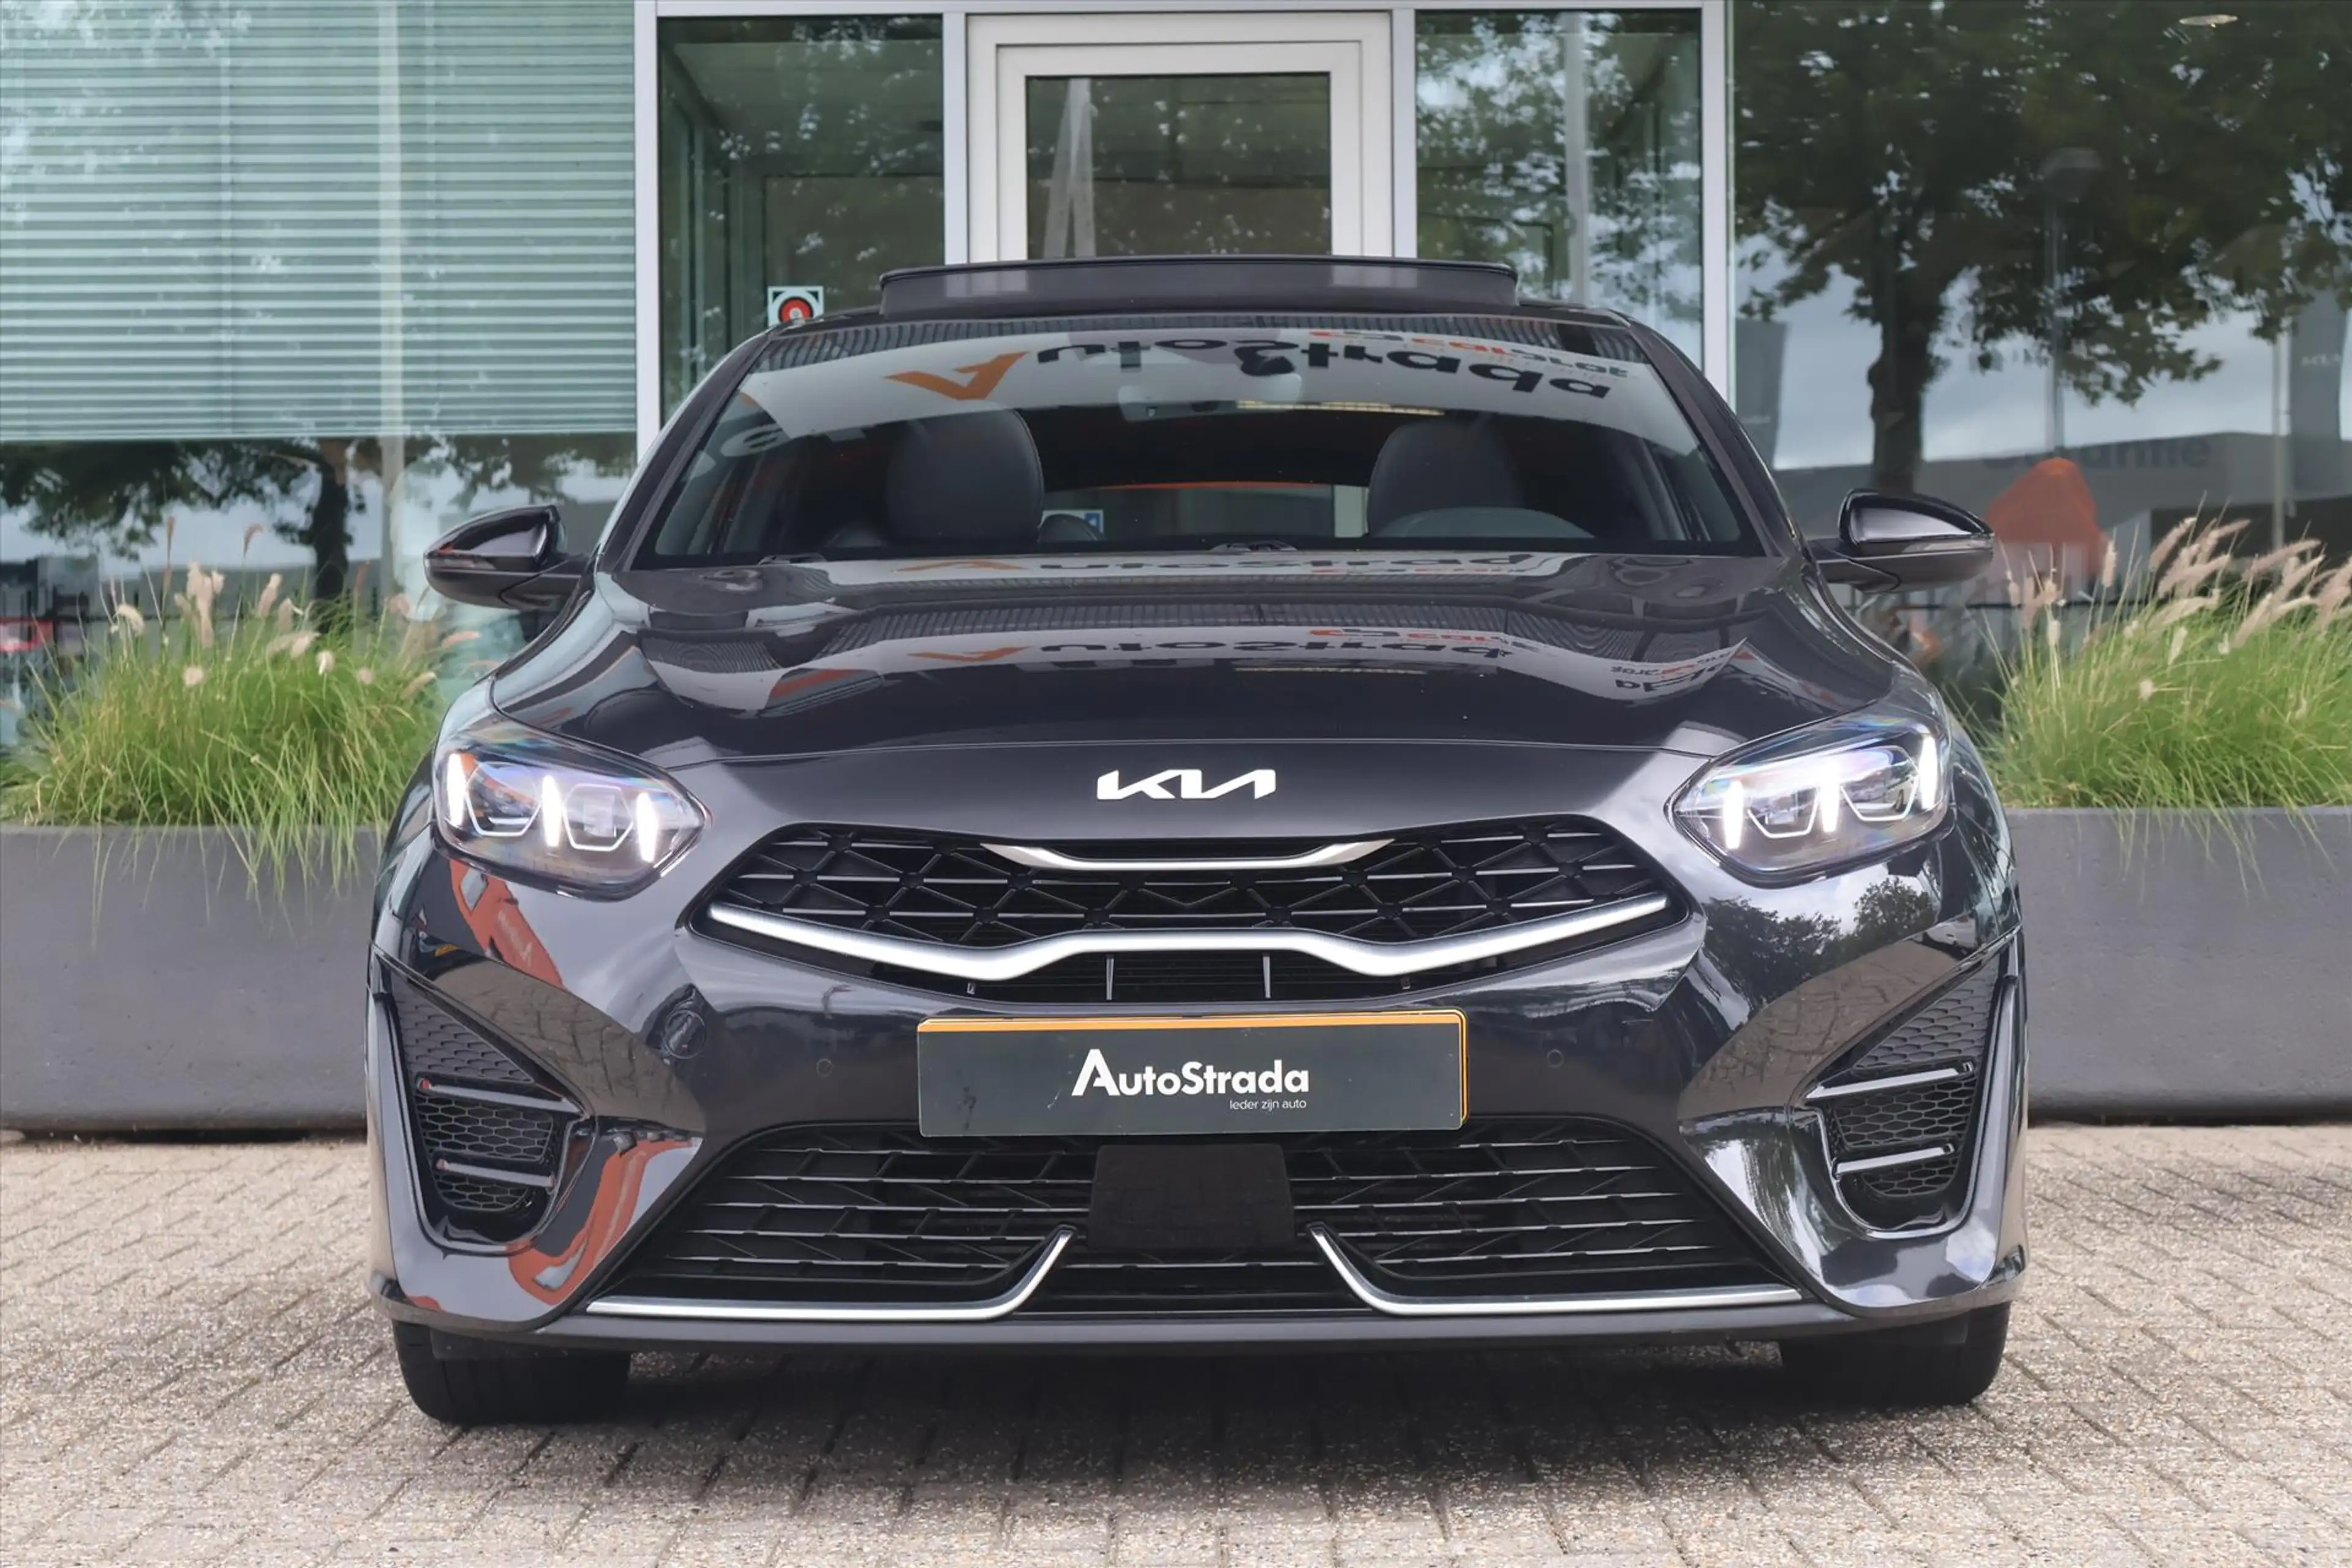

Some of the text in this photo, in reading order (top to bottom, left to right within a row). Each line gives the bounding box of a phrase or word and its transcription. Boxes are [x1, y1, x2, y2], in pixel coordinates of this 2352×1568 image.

[1097, 769, 1276, 799] KIA
[1071, 1048, 1310, 1096] AutoStrada
[1261, 1099, 1280, 1112] zijn
[1281, 1099, 1307, 1109] auto
